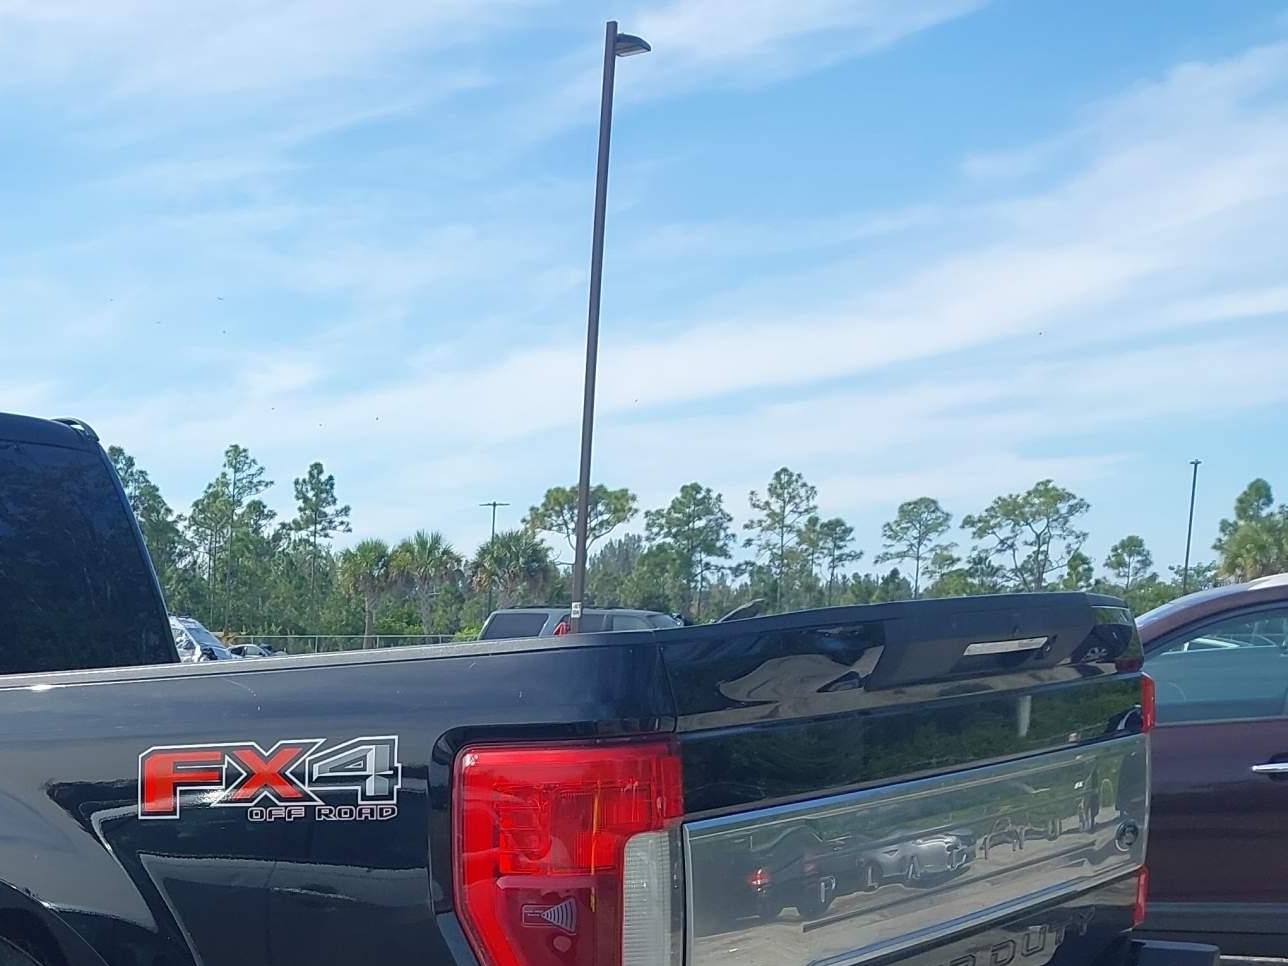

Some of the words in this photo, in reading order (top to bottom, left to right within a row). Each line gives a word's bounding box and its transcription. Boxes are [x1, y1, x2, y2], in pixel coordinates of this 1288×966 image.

[138, 735, 402, 819] FX4
[247, 804, 305, 821] OFF
[315, 804, 398, 821] ROAD
